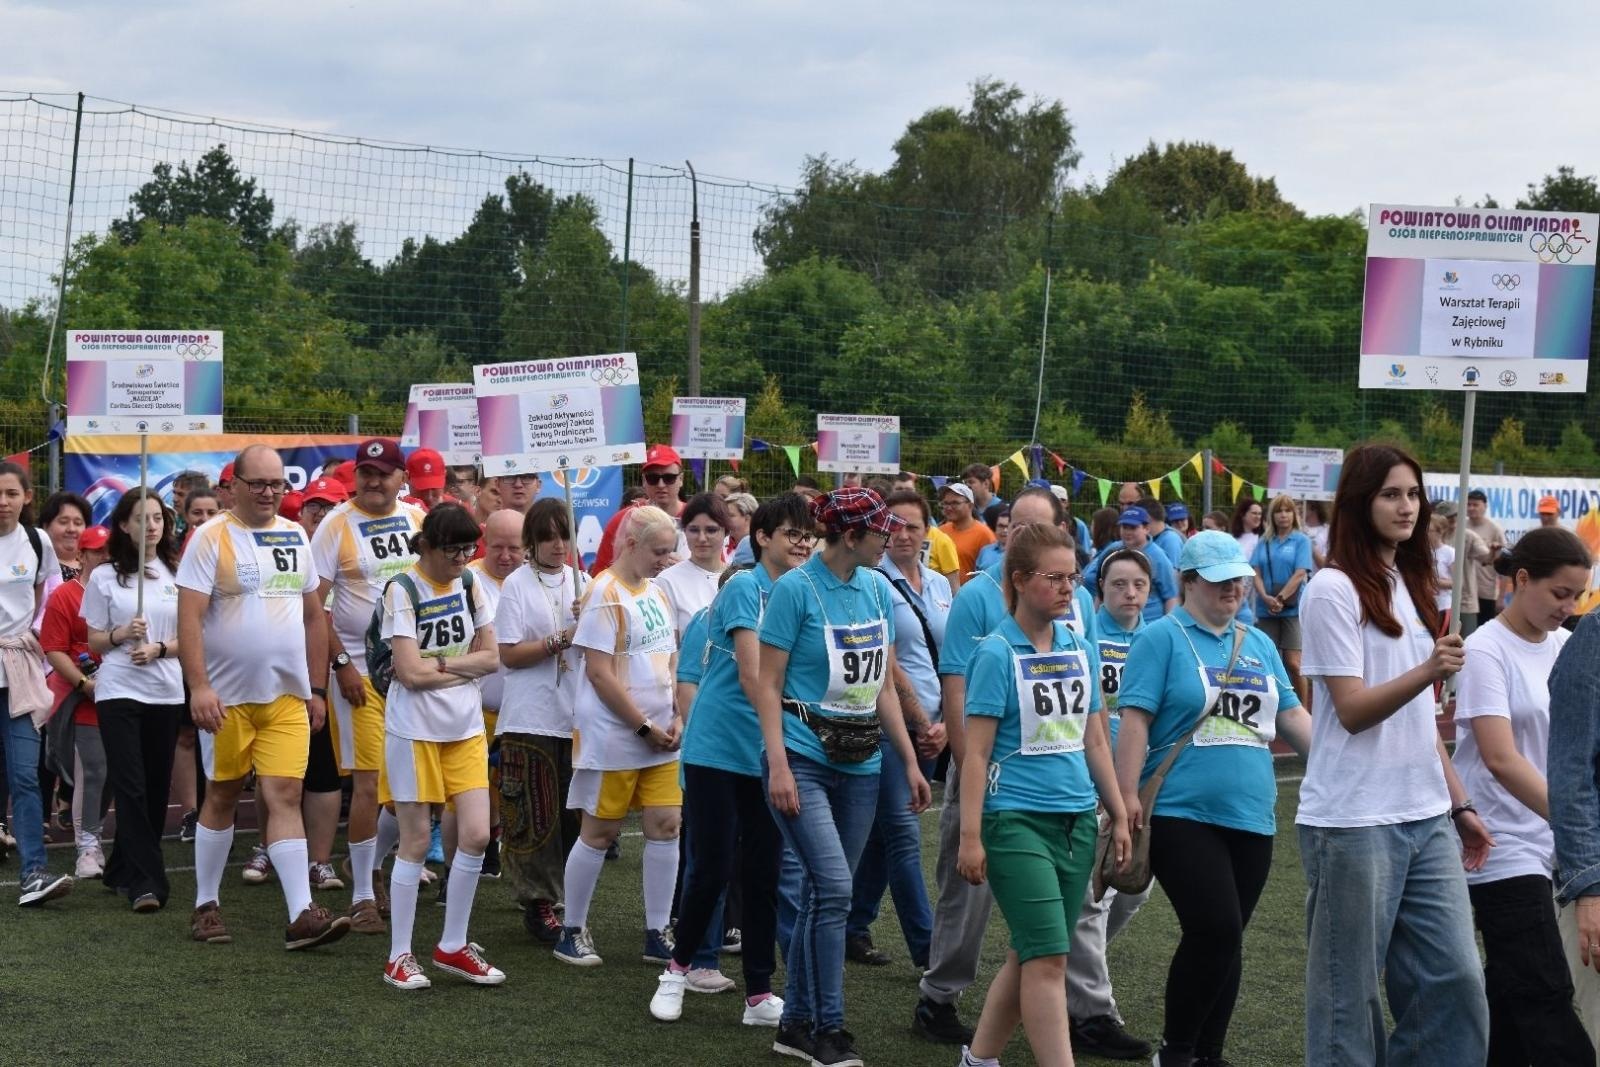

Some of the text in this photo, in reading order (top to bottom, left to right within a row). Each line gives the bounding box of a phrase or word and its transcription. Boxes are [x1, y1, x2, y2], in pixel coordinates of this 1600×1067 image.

[1380, 210, 1570, 233] POWIATOWA OLIMPIADA
[1388, 227, 1523, 243] OSÓB NIEPEŁNOSPRAWNYCH
[1440, 296, 1520, 311] Warsztat Terapii
[1452, 316, 1506, 330] Zajęciowej
[75, 334, 204, 343] POWIATOWA OLIMPIADA
[1451, 336, 1503, 349] w Rybniku
[482, 357, 618, 377] POWIATOWA OLIMPIADA
[423, 388, 474, 396] POWIATOWA
[527, 409, 595, 422] Zakład Aktywności
[529, 418, 595, 431] Zawodowej Zakład
[531, 427, 595, 440] Usług Pralniczych
[272, 548, 298, 572] 67
[420, 615, 466, 649] 769
[843, 648, 883, 684] 970
[1102, 664, 1126, 694] 8
[1032, 680, 1085, 716] 612
[1211, 691, 1262, 729] 02
